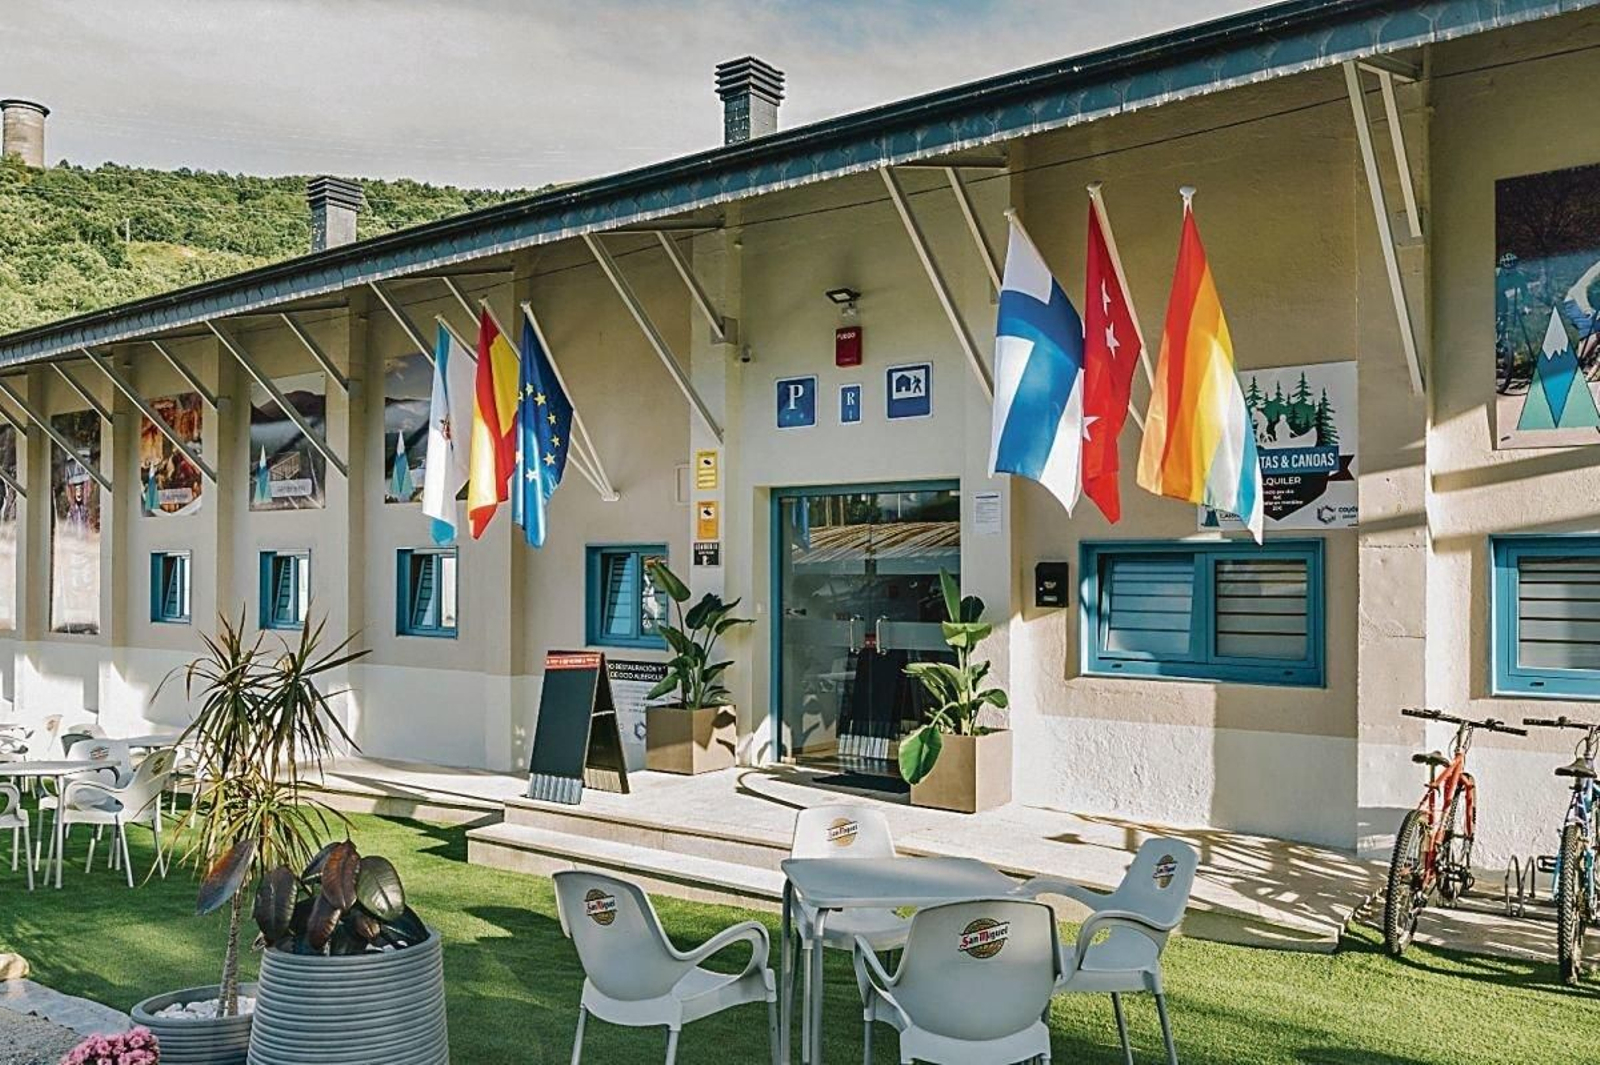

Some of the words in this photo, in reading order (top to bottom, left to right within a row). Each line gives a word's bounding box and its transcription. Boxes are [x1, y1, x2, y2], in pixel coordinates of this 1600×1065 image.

[788, 384, 804, 410] P
[846, 391, 855, 405] R
[1260, 455, 1278, 469] TAS
[1280, 454, 1290, 468] &
[1291, 452, 1335, 468] CANOAS
[1262, 476, 1302, 486] LQUILER
[959, 935, 979, 946] San
[979, 926, 1008, 942] Miguel
